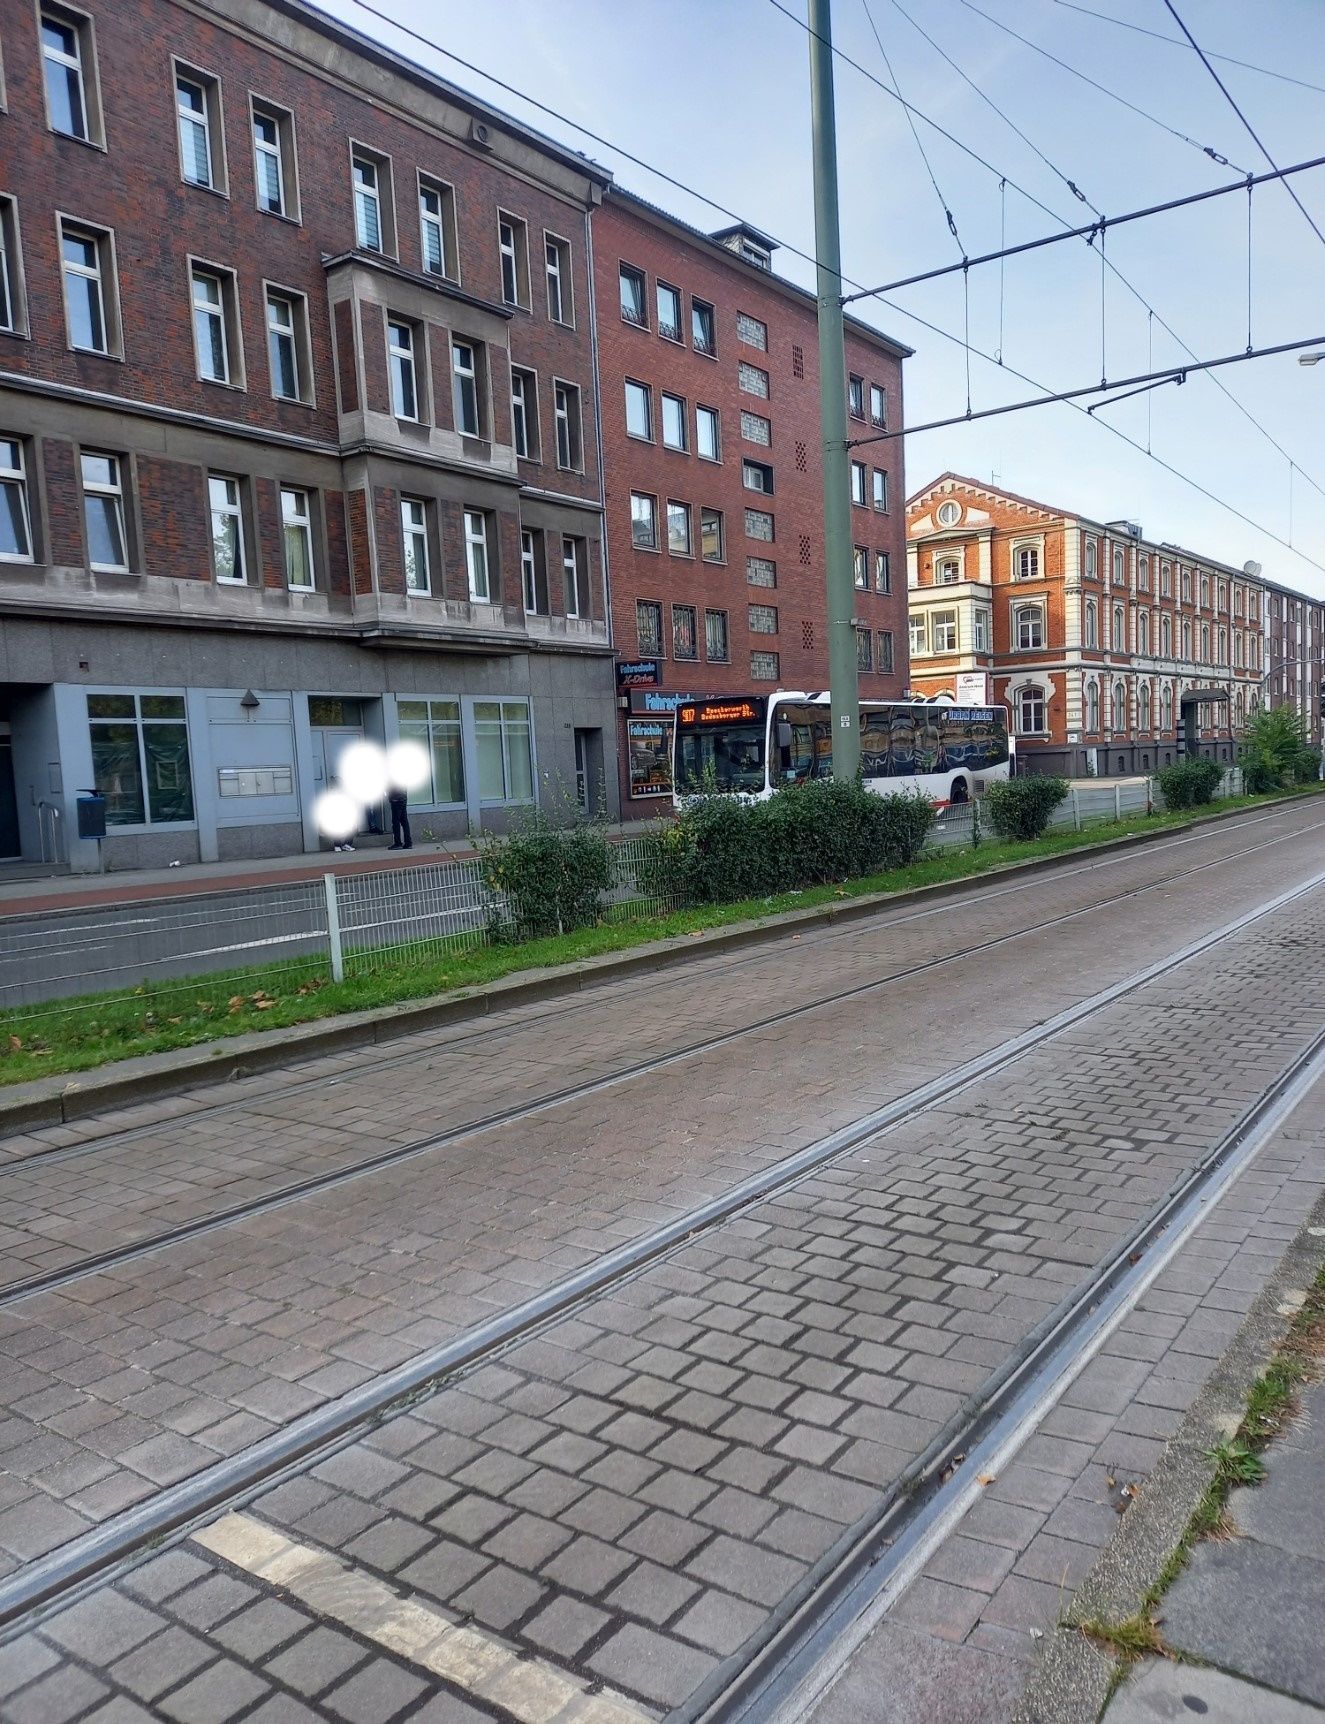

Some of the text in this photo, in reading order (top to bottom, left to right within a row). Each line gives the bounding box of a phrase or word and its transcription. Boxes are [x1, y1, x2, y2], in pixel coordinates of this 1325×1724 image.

[620, 662, 655, 674] Fahrschule
[682, 708, 695, 722] 907
[629, 724, 663, 736] Fahrschule
